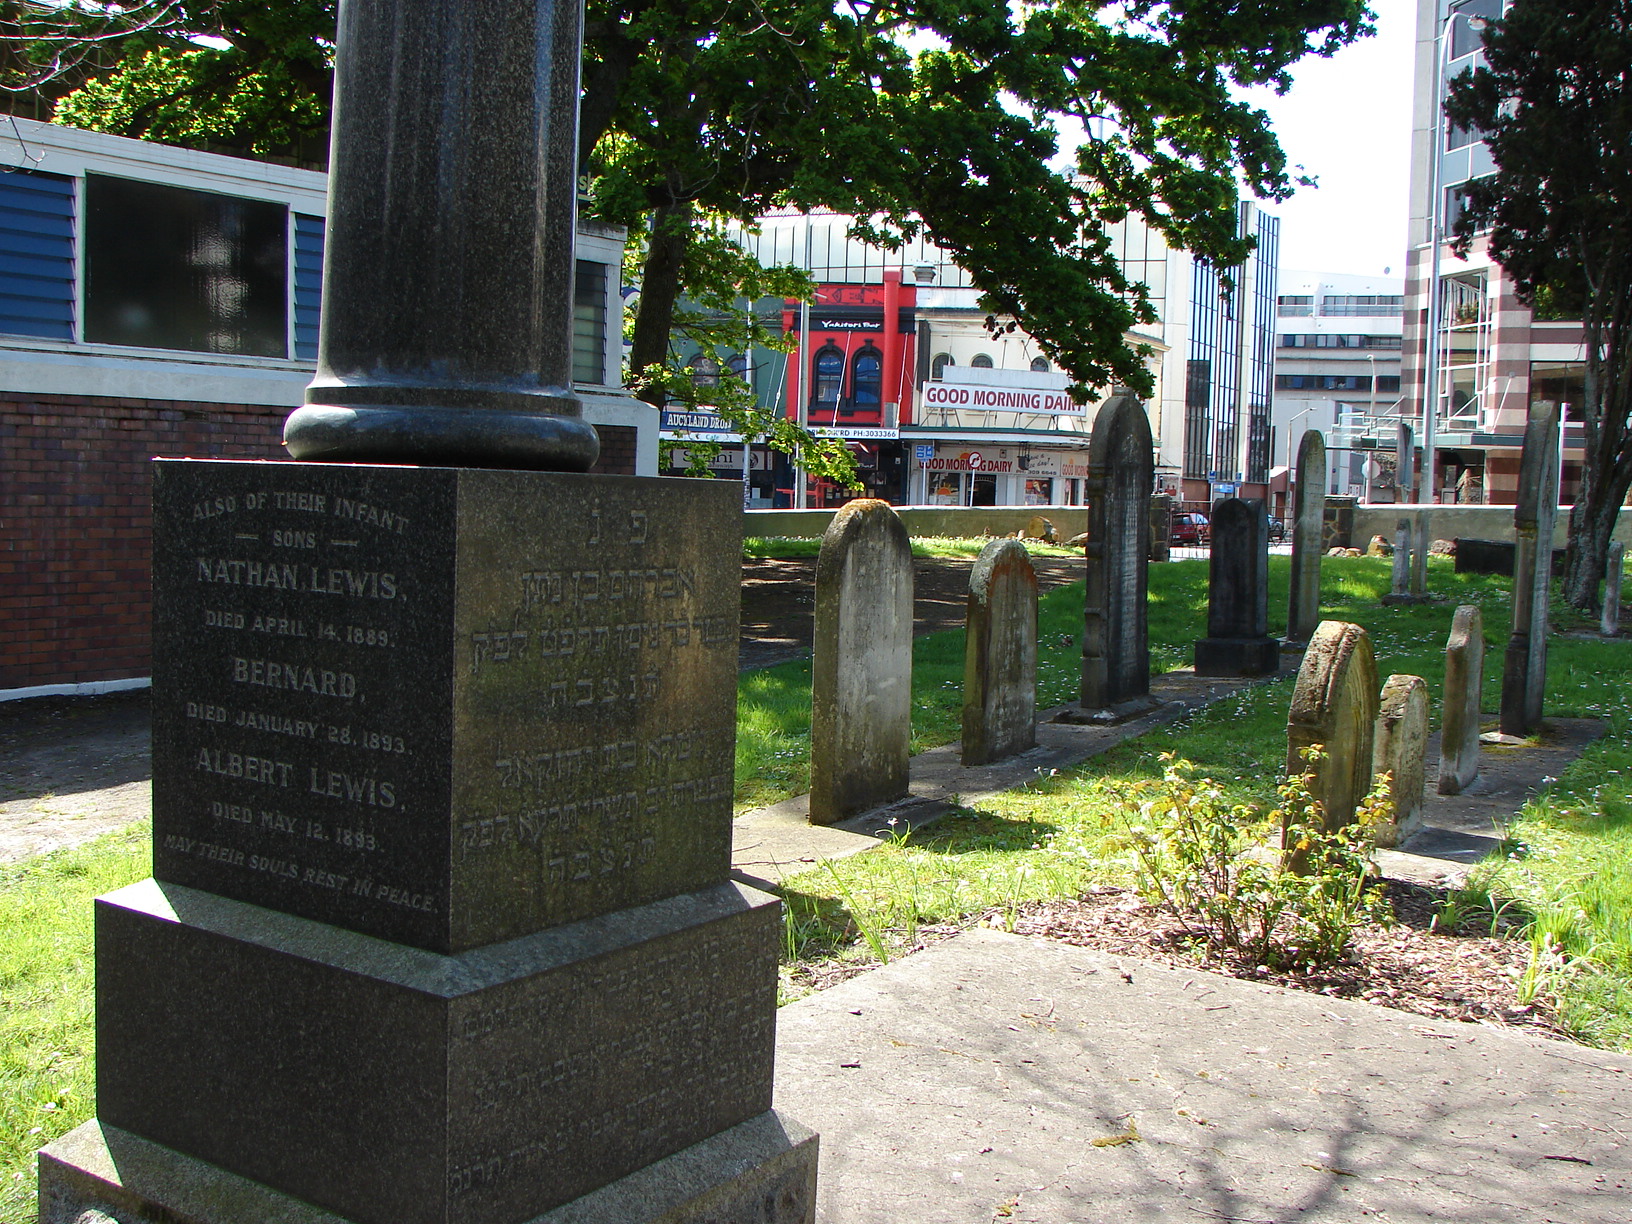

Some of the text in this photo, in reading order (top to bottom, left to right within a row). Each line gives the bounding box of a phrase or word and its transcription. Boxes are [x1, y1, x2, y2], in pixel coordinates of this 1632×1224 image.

[822, 320, 881, 329] Yakitori Bar
[927, 387, 969, 404] GOOD
[973, 390, 1040, 409] MORNING
[987, 460, 1013, 473] DAIRY
[193, 491, 409, 534] ALSO OF THEIR INFANT
[273, 529, 316, 549] SONS
[198, 556, 299, 590] NATHAN
[205, 609, 245, 630] DIED
[252, 615, 308, 637] APRIL
[186, 702, 227, 723] DIED
[235, 711, 319, 740] JANUARY
[197, 747, 293, 787] ALBERT
[212, 802, 252, 824] DIED
[260, 810, 298, 833] MAY
[163, 834, 440, 914] MAY THEIR SOULS REST IN PEACE.
